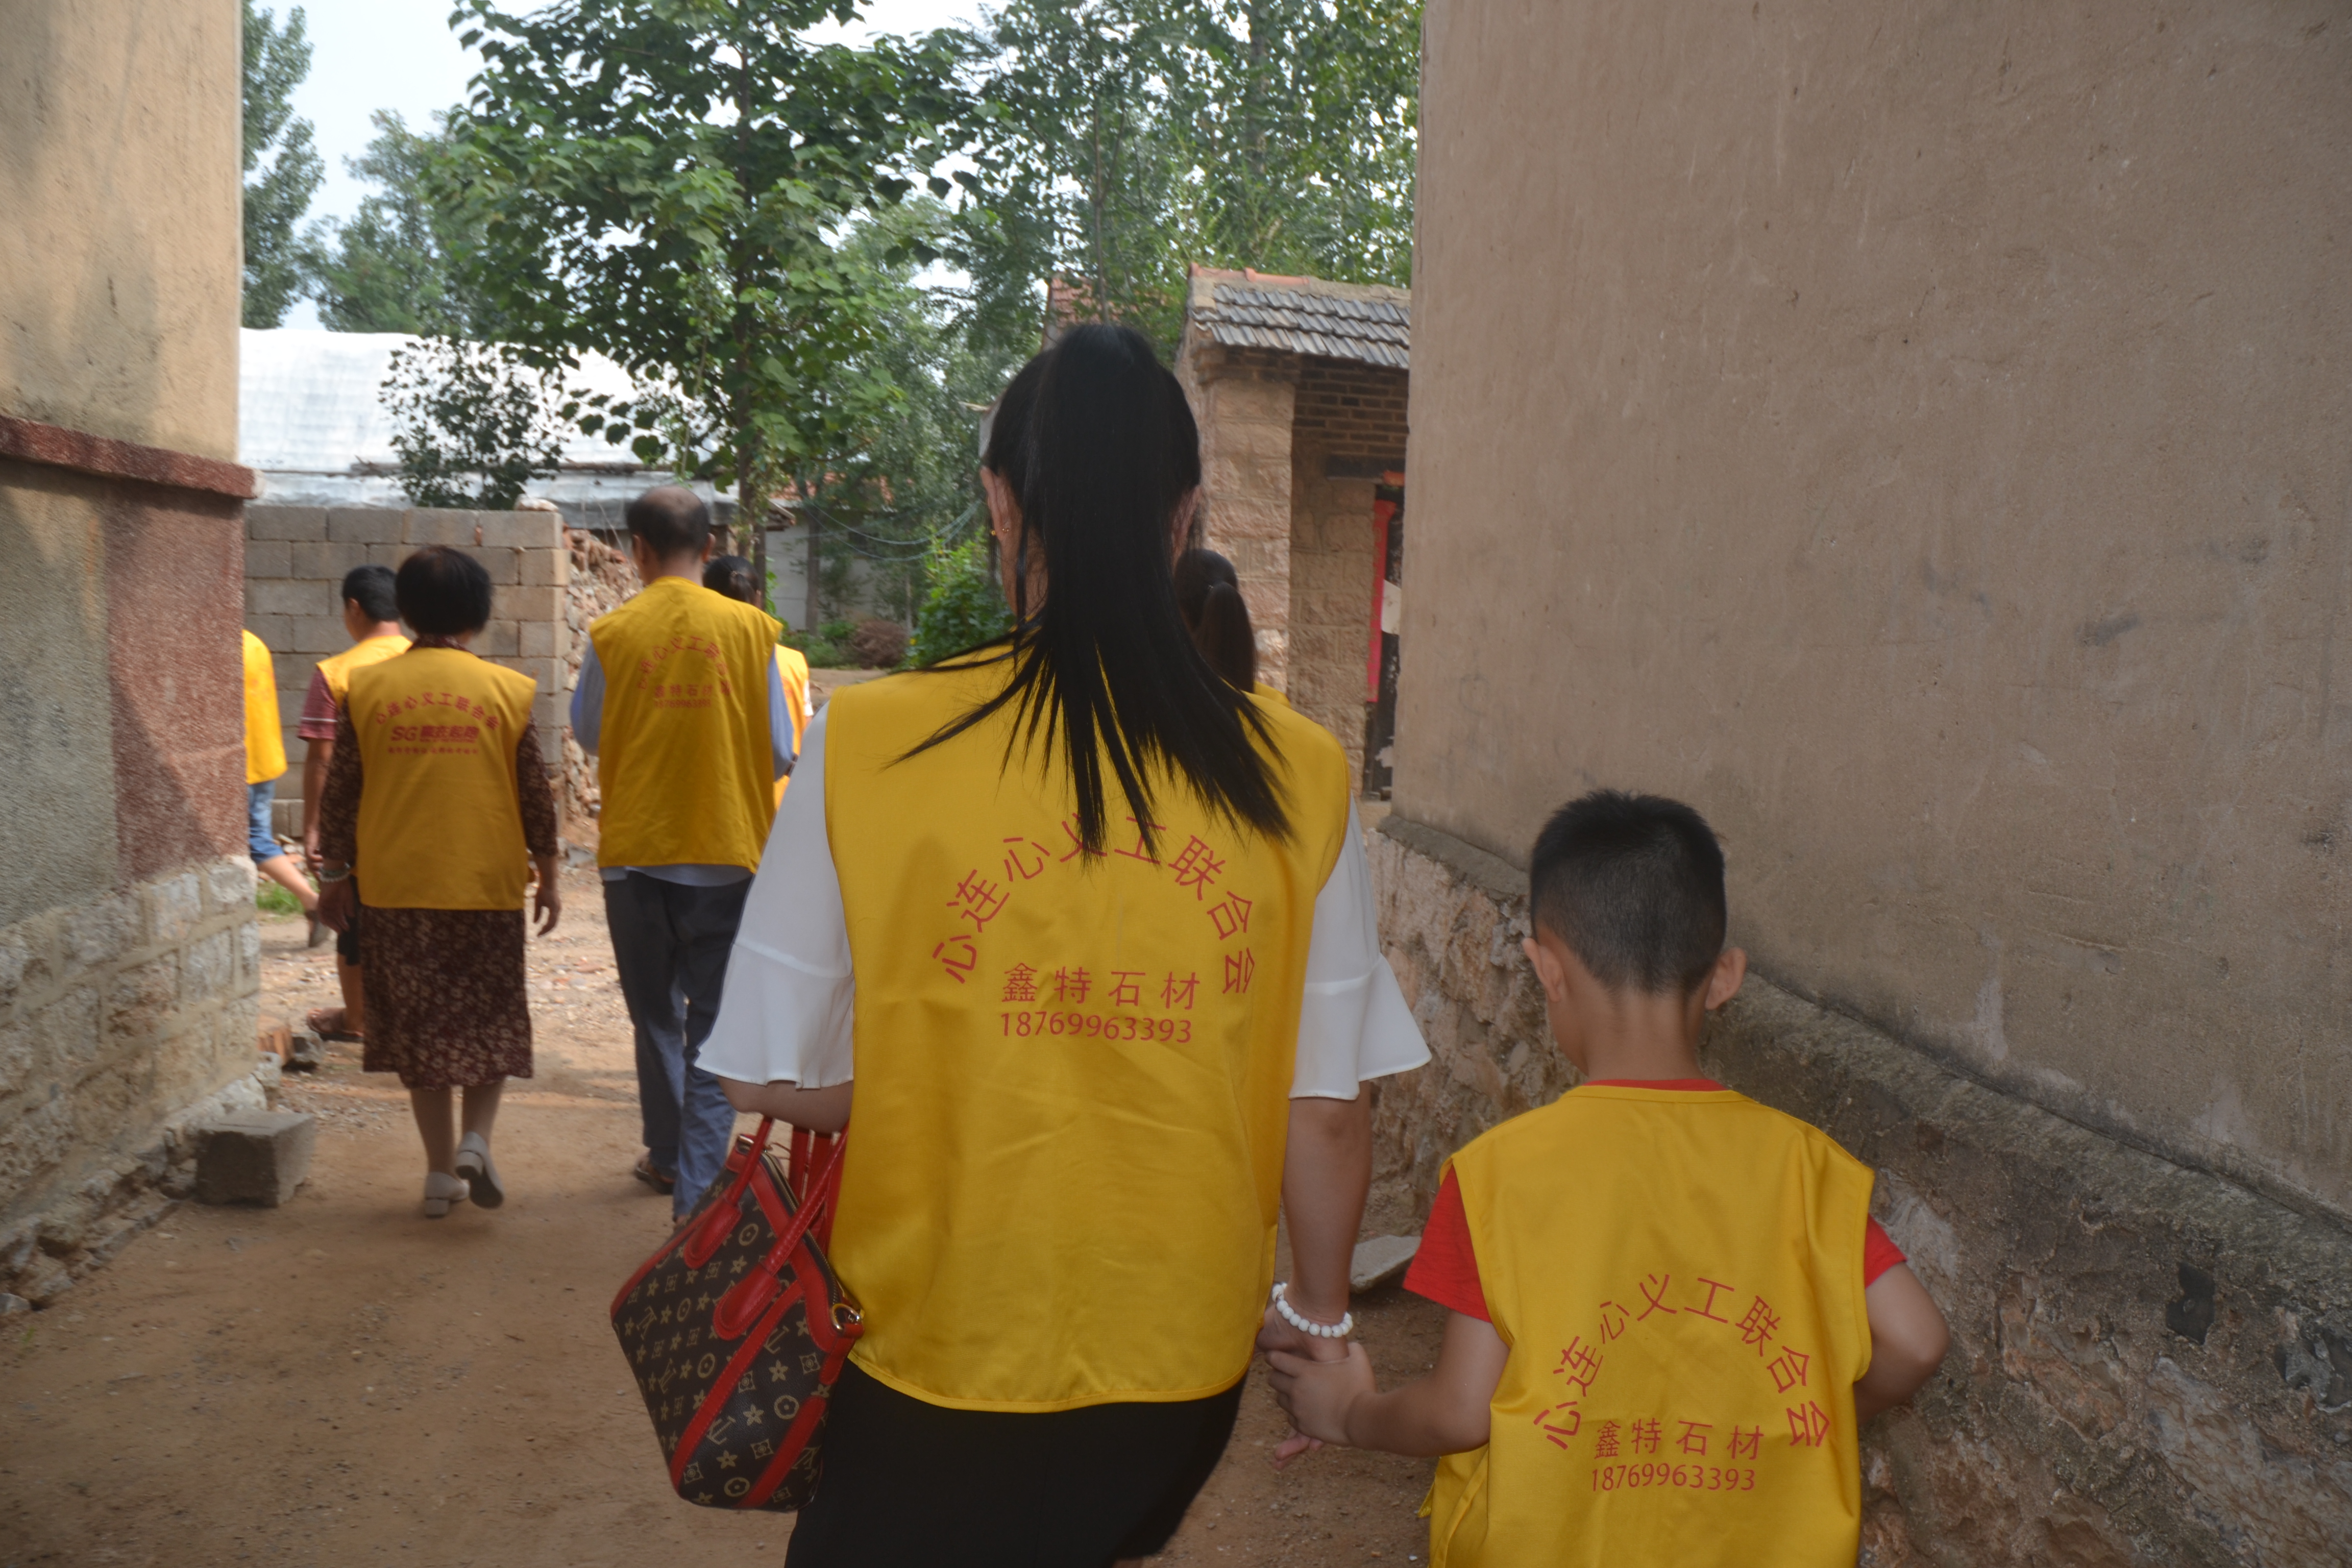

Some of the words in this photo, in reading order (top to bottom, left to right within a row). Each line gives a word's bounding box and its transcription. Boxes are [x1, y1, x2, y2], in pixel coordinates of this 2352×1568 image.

[391, 726, 418, 741] SG
[932, 813, 1255, 994] 心连心义工联合会
[1001, 963, 1200, 1011] 鑫特石材
[1000, 1011, 1192, 1043] 18769963393
[1533, 1274, 1830, 1450] 心连心义工联合会
[1594, 1417, 1765, 1460] 鑫特石材
[1591, 1462, 1756, 1491] 18769963393
